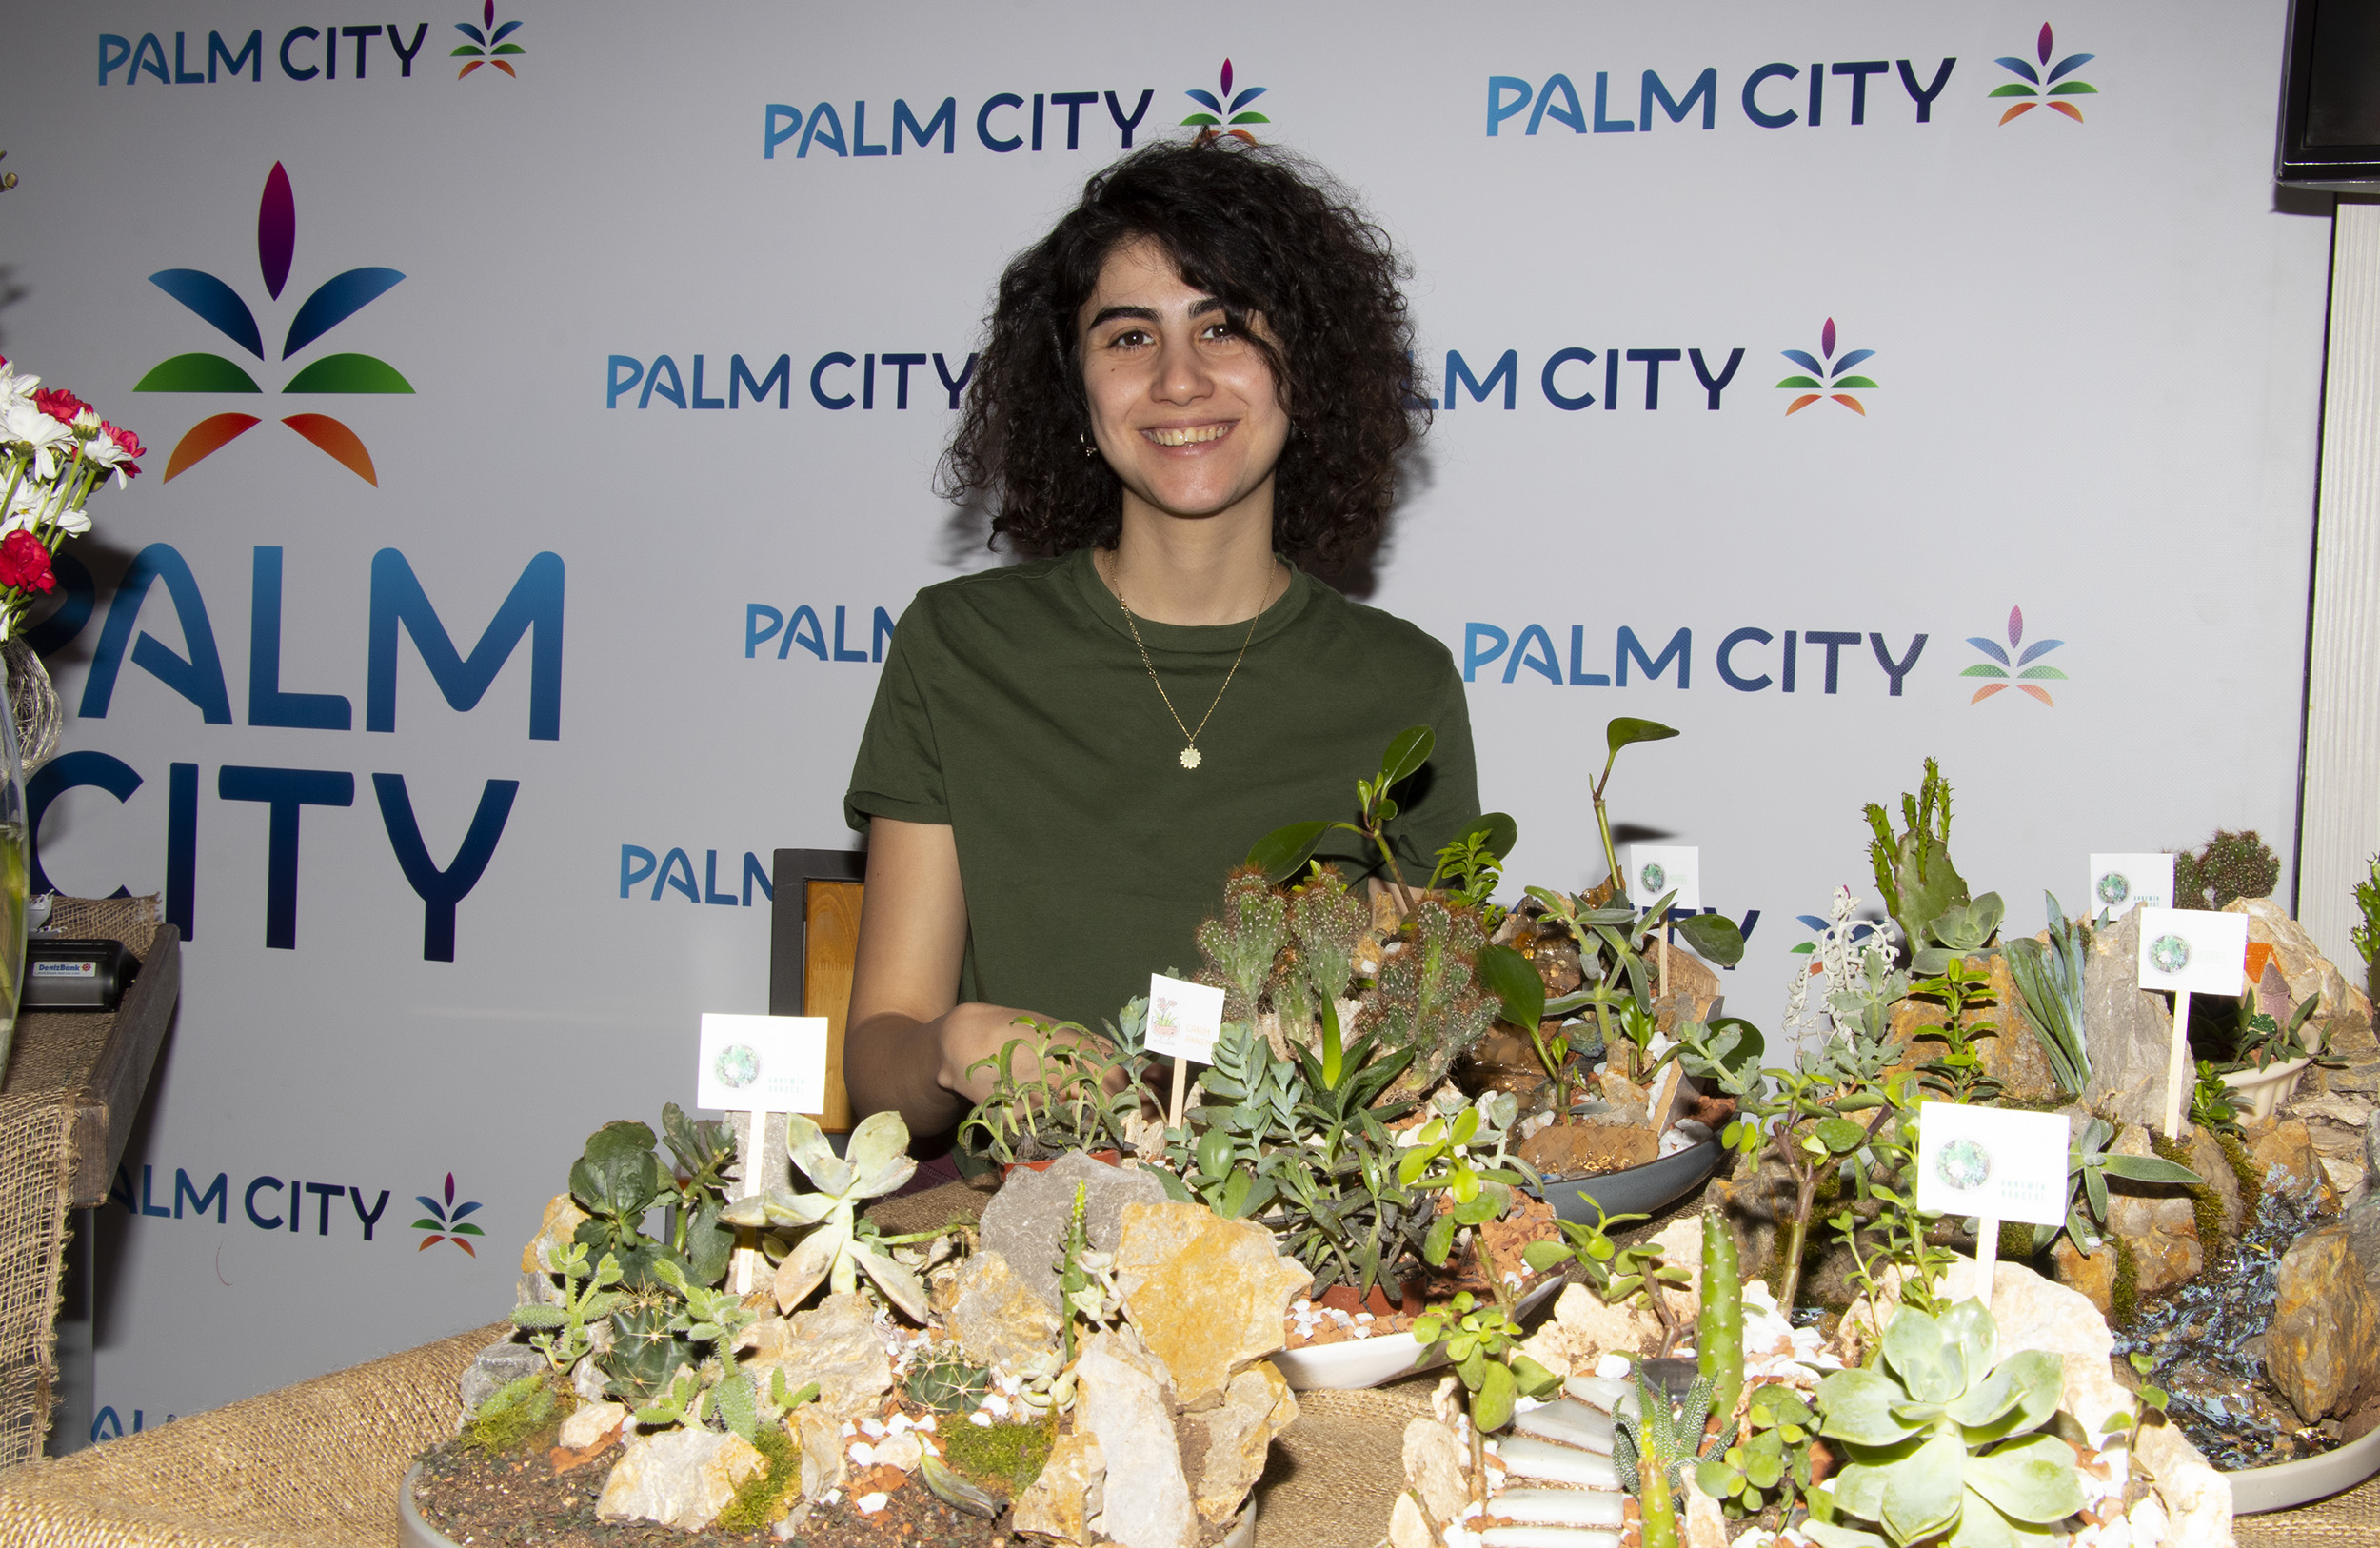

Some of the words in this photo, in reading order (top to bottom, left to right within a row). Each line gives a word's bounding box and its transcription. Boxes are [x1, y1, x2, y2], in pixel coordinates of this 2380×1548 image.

[98, 30, 262, 86] PALM
[280, 23, 428, 82] CITY
[764, 97, 956, 159] PALM
[976, 89, 1155, 152] CITY
[1486, 67, 1717, 137] PALM
[1741, 57, 1957, 129] CITY
[606, 354, 790, 410] PALM
[810, 351, 980, 410] CITY
[1402, 348, 1517, 410] LM
[1541, 347, 1746, 411] CITY
[1463, 622, 1692, 689] PALM
[1716, 627, 1929, 697] CITY
[25, 750, 520, 962] CITY
[110, 1162, 228, 1224] ALM
[244, 1175, 390, 1241] CITY
